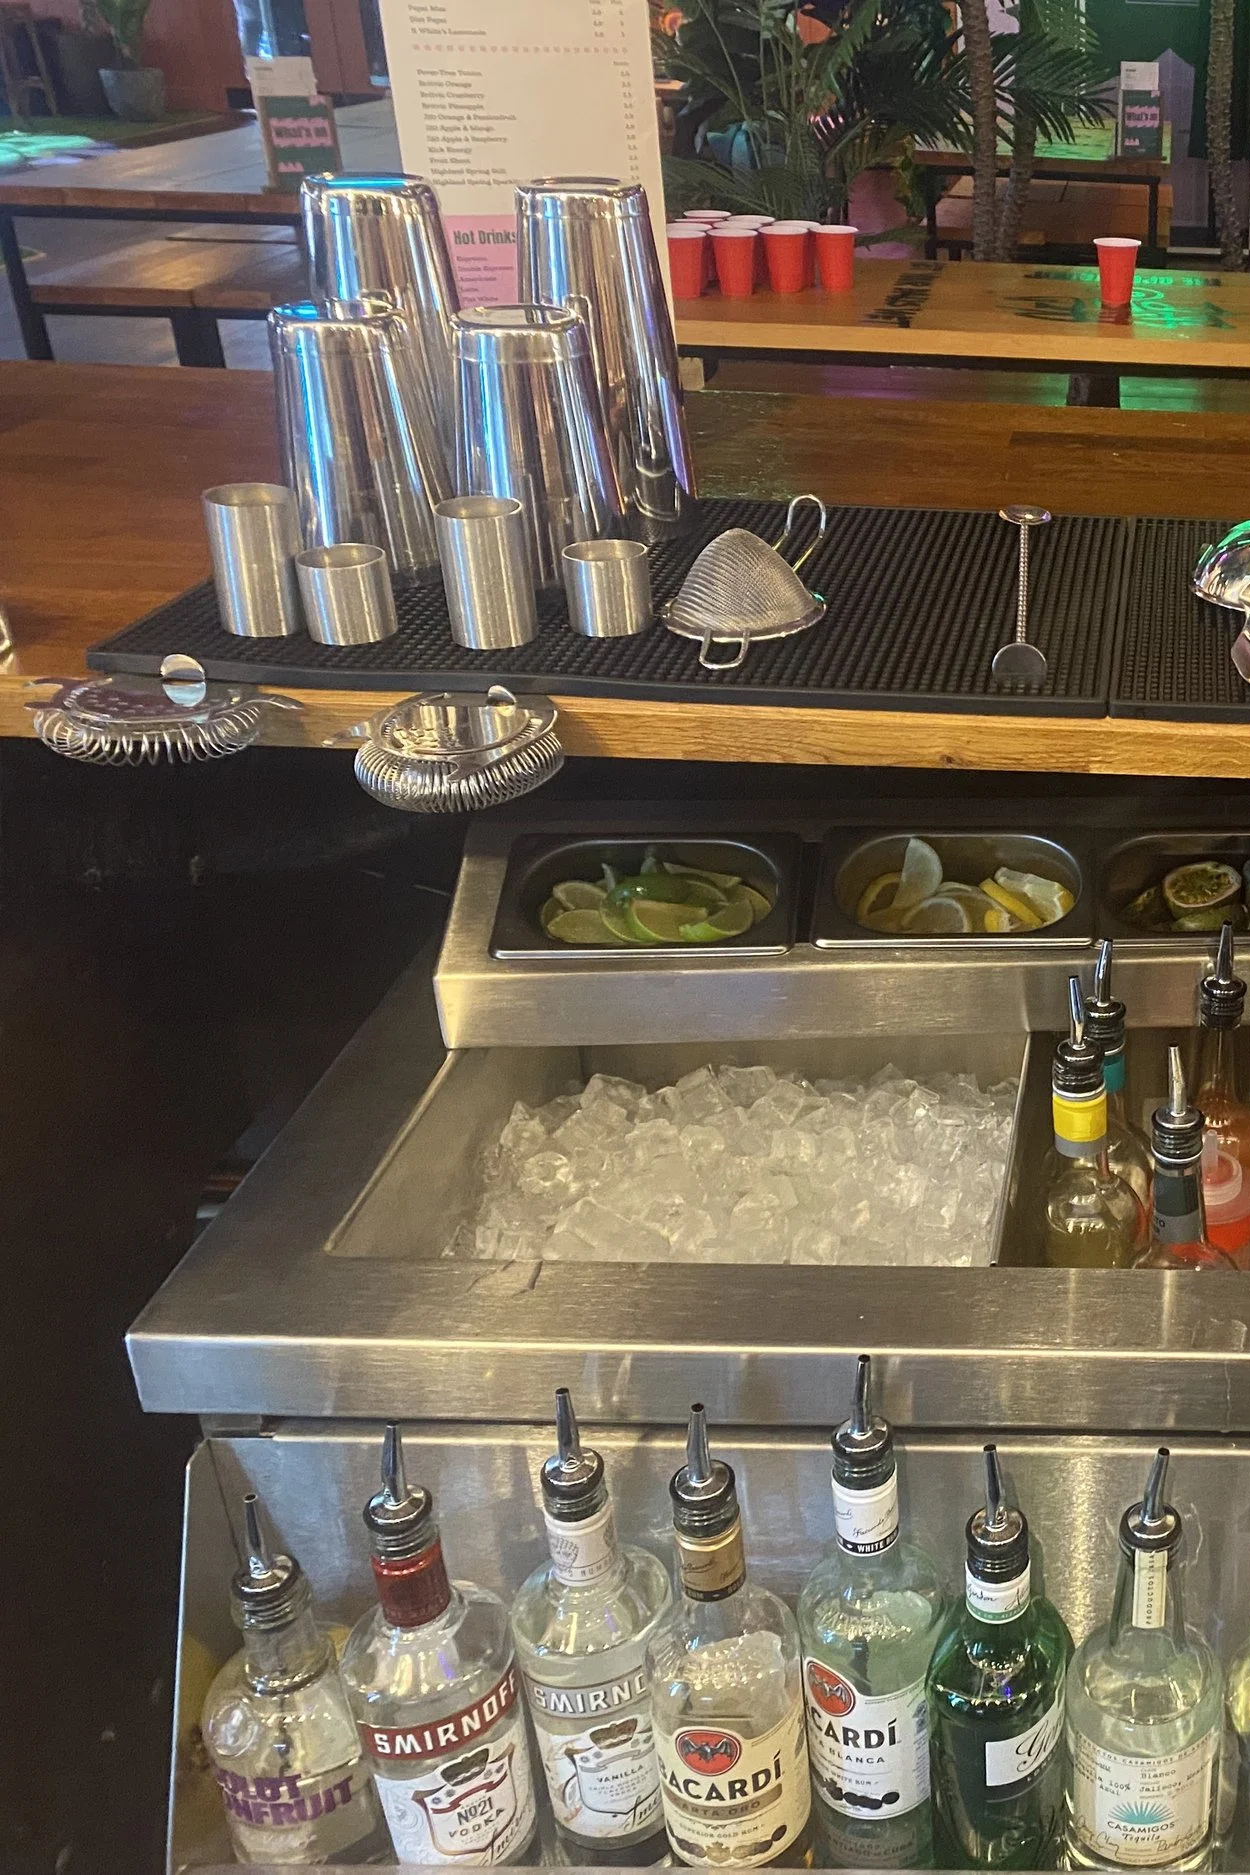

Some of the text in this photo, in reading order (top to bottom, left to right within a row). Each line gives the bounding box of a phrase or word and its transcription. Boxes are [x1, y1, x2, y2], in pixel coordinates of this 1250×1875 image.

[453, 230, 475, 245] Hot
[857, 1536, 885, 1554] WHITE
[373, 1669, 516, 1755] SMIRNOFF
[806, 1706, 898, 1750] CARDÍ
[829, 1747, 885, 1764] BLANCA
[597, 1764, 644, 1783] VANILLA
[1141, 1768, 1177, 1780] Blanco
[728, 1800, 761, 1816] ORO
[448, 1807, 505, 1838] VODKA
[1107, 1820, 1176, 1834] CASAMIGOS
[1121, 1833, 1161, 1845] Tequila
